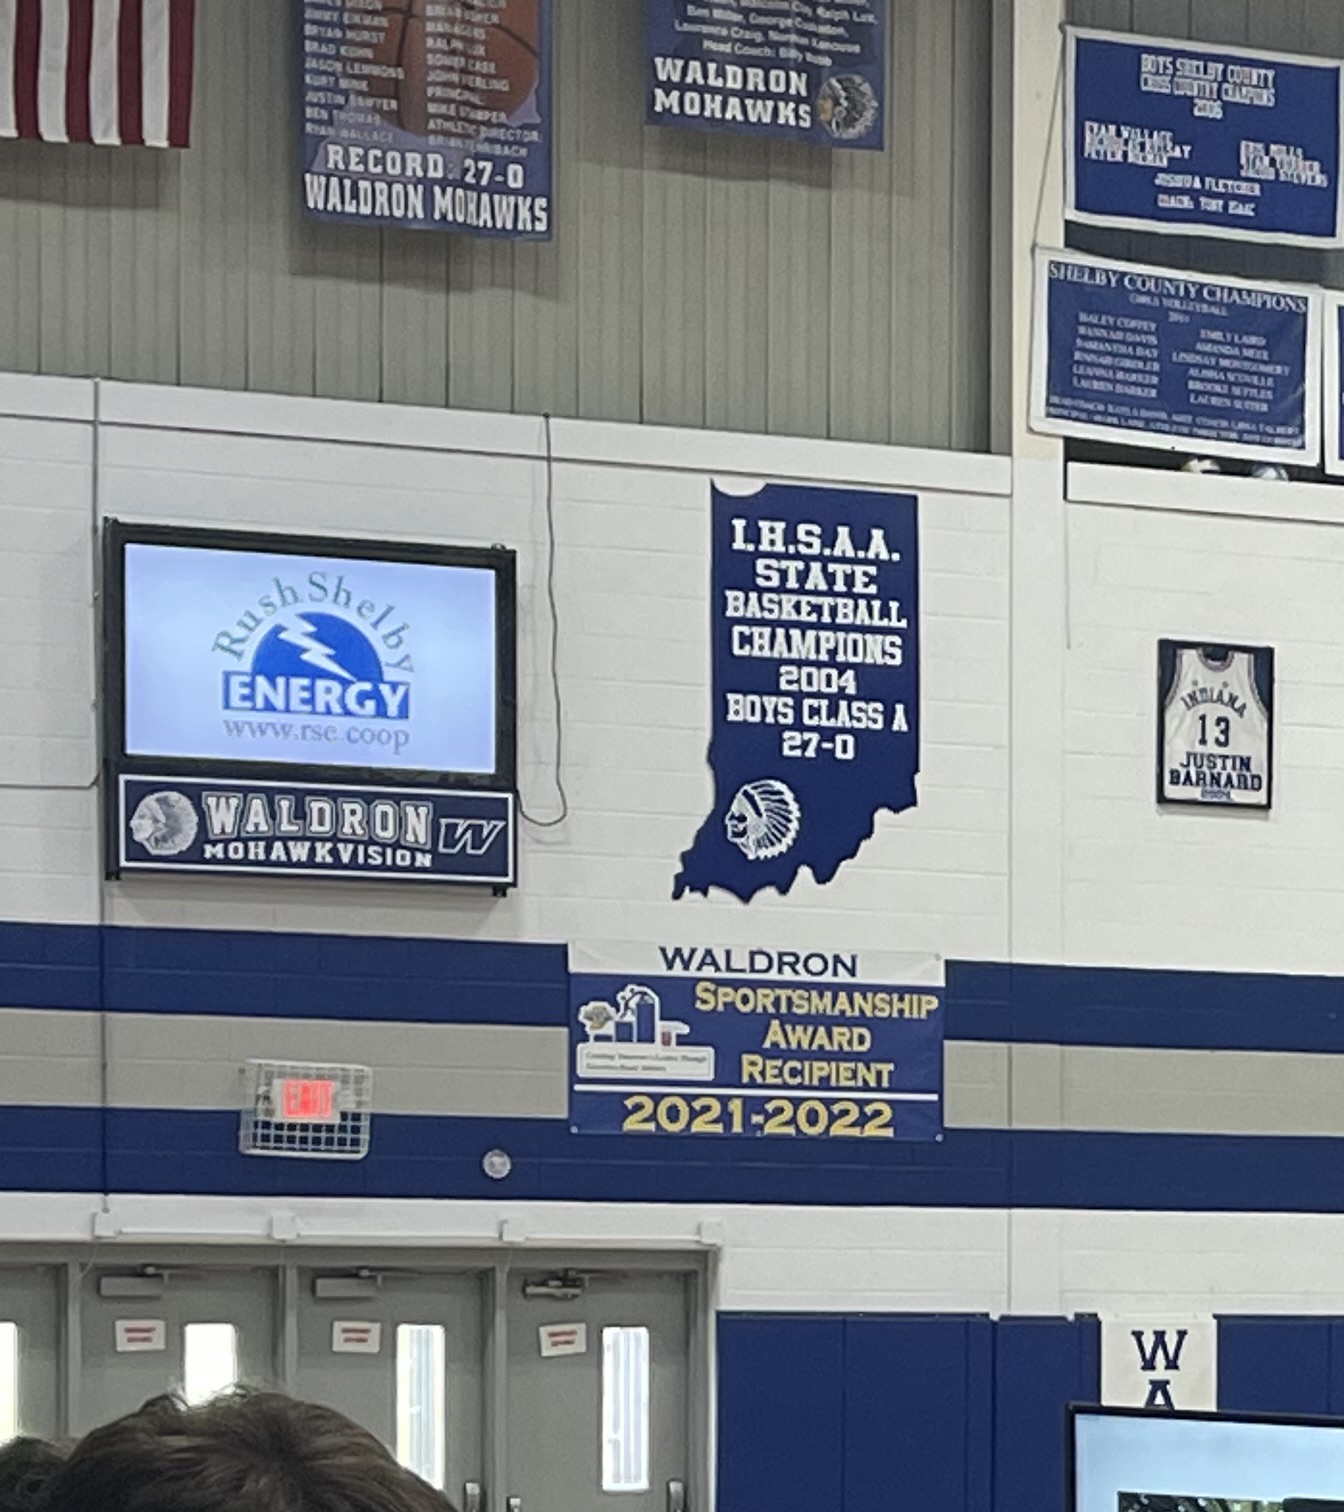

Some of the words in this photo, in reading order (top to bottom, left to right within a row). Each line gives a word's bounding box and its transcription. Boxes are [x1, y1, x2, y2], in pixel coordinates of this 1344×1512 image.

[654, 57, 808, 97] WALDRON
[653, 88, 812, 128] MOHAWKS
[464, 158, 524, 189] 27-0
[304, 173, 424, 219] WALDRON
[433, 185, 548, 232] MOHAWKS
[1050, 262, 1120, 289] SHELBY
[1123, 274, 1200, 301] COUNTY
[1203, 285, 1307, 313] CHAMPIONS
[730, 517, 901, 562] I.H.S.A.A.
[755, 557, 878, 595] STATE
[306, 571, 415, 674] Shelby
[724, 589, 908, 629] BASKETBALL
[731, 625, 903, 666] CHAMPIONS
[229, 675, 406, 718] ENERGY
[779, 665, 858, 696] 2004
[726, 693, 794, 726] BOYS
[801, 697, 884, 731] CLASS
[891, 703, 909, 733] A
[1180, 687, 1247, 719] INDIANA
[781, 730, 856, 761] 27-0
[1198, 714, 1230, 748] 13
[1169, 769, 1263, 792] BARNARD
[1179, 751, 1252, 772] JUSTIN
[203, 791, 432, 849] WALDRON
[659, 945, 858, 978] WALDRON
[694, 981, 939, 1020] SPORTSMANSHIP
[762, 1018, 872, 1053] AWARD
[740, 1053, 895, 1089] RECIPIENT
[621, 1094, 895, 1138] 2021-2022
